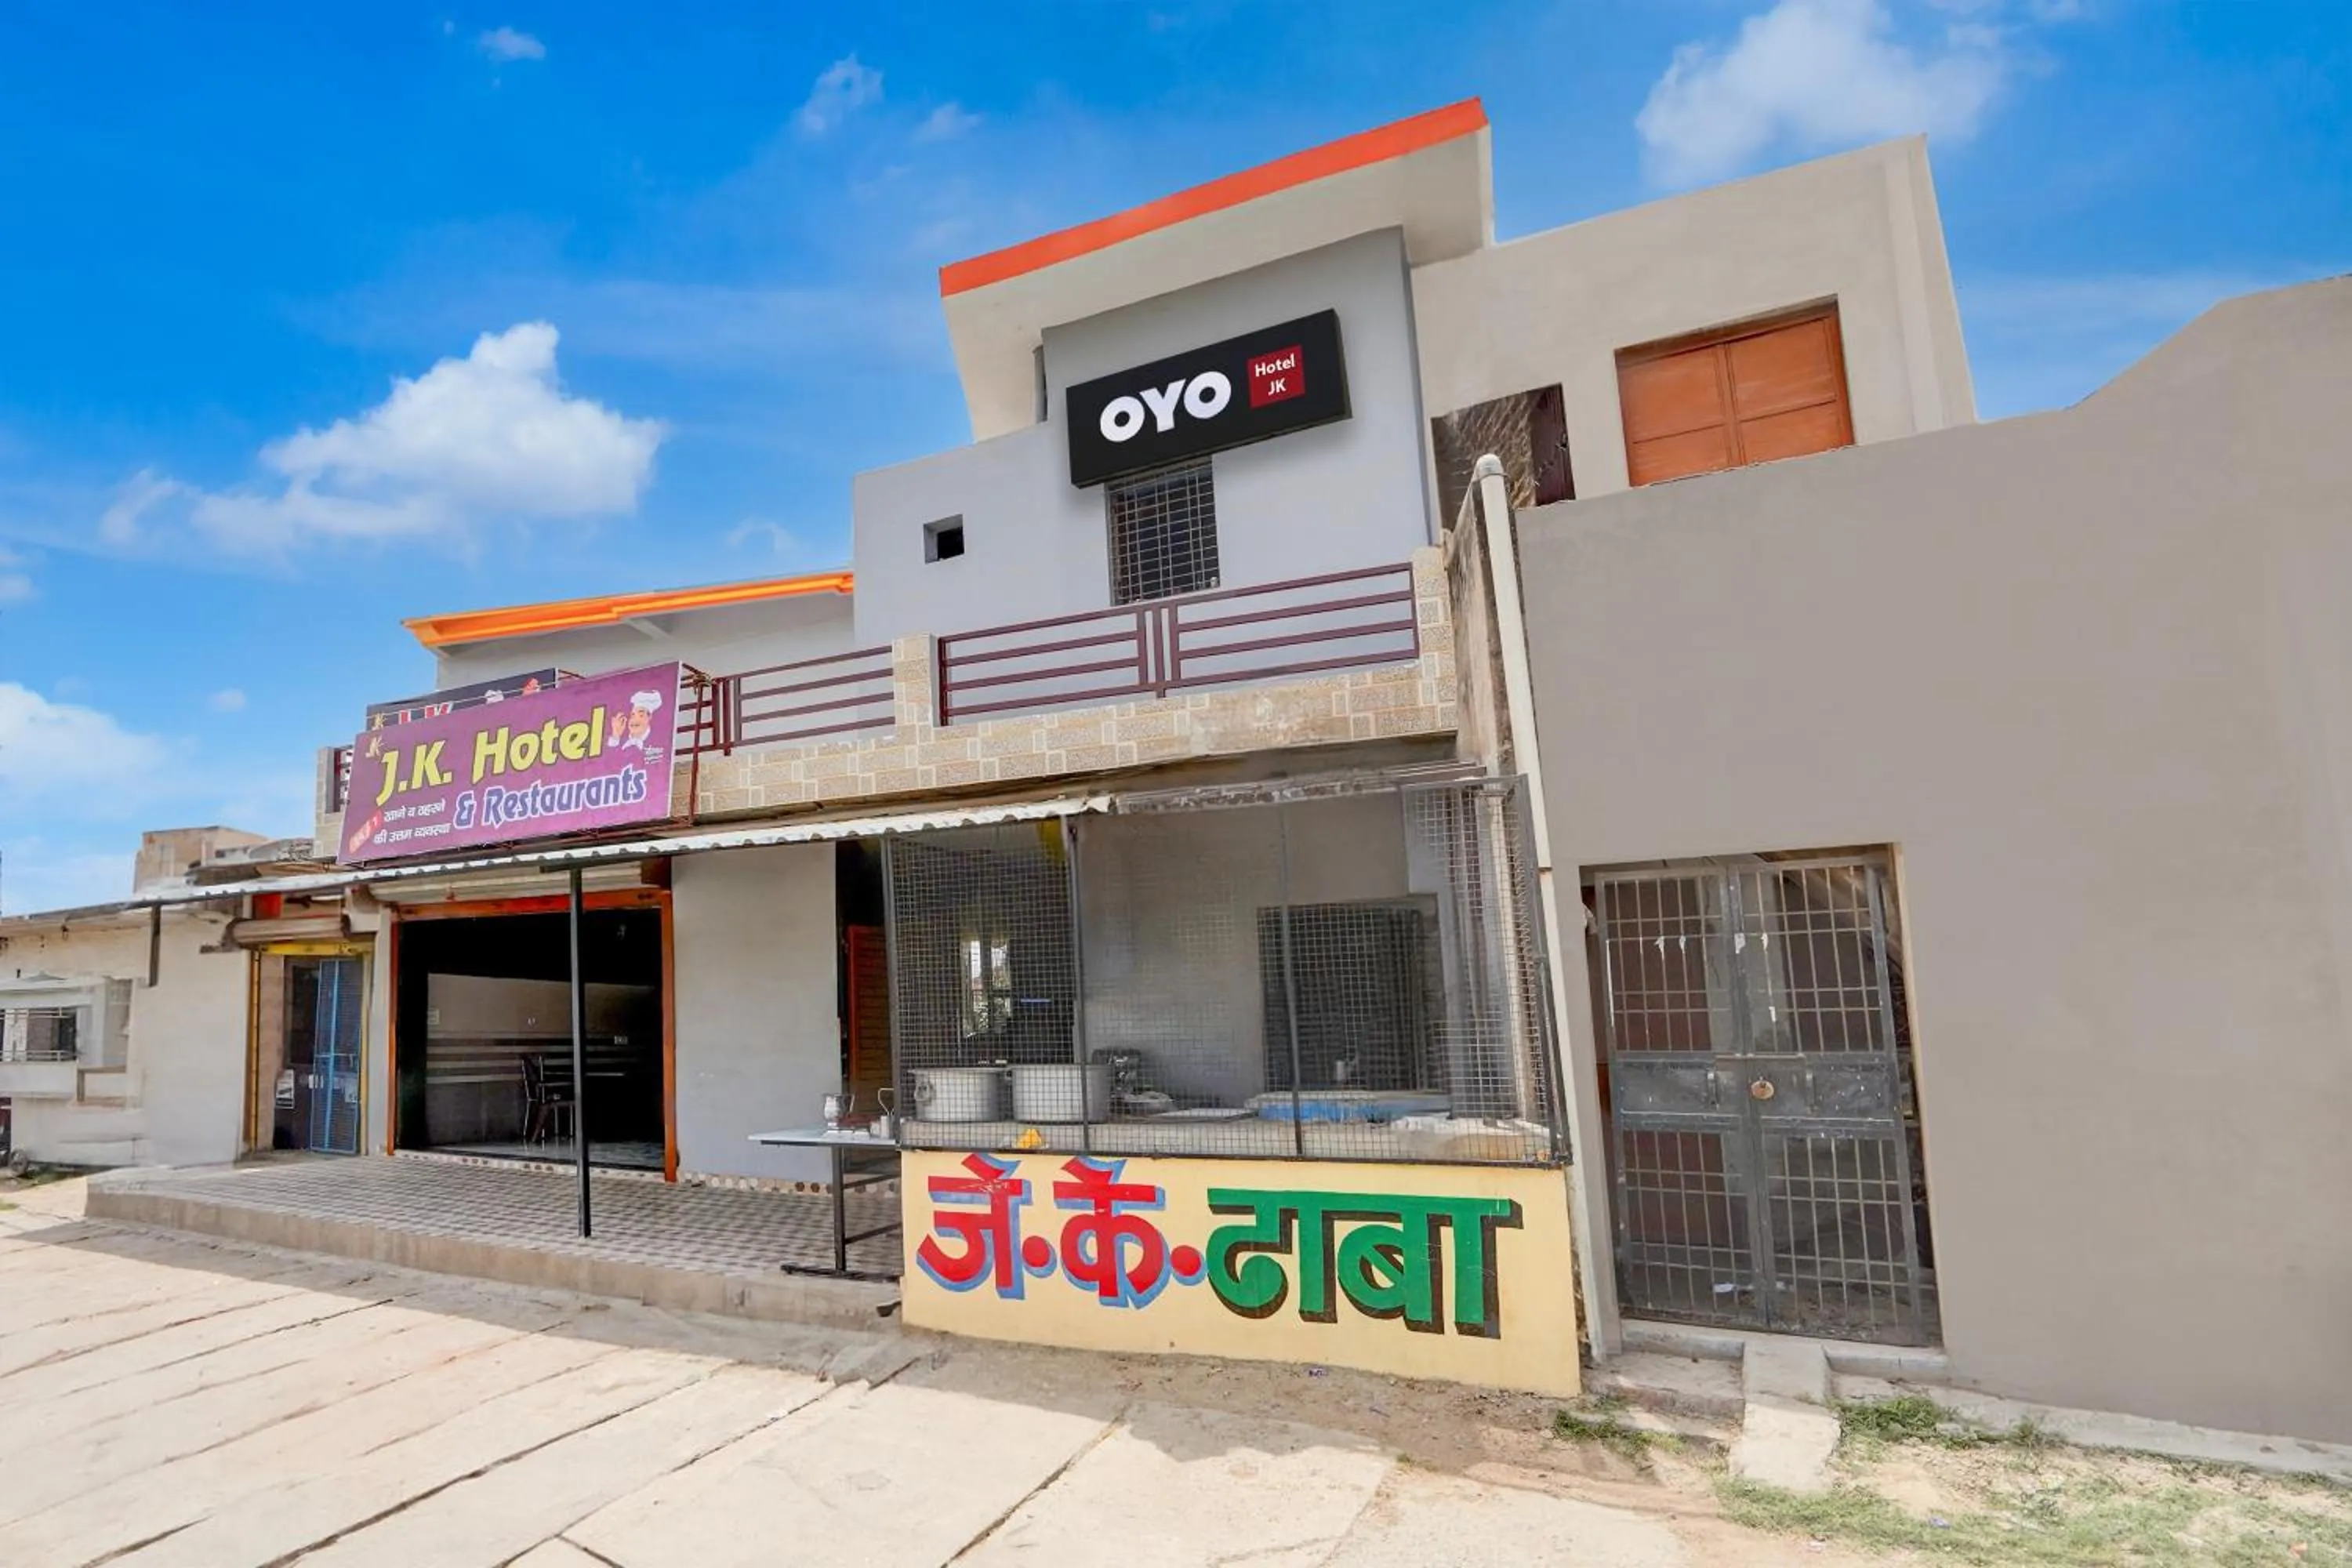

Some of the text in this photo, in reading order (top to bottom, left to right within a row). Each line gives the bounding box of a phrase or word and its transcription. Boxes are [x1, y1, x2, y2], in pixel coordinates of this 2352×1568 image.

[1254, 353, 1296, 377] Hotel
[1268, 378, 1287, 396] JK
[1100, 371, 1232, 442] OYO
[376, 706, 606, 806] J.K. Hotel
[452, 763, 647, 829] & Restaurants
[373, 829, 387, 845] की
[389, 829, 412, 843] उत्तम
